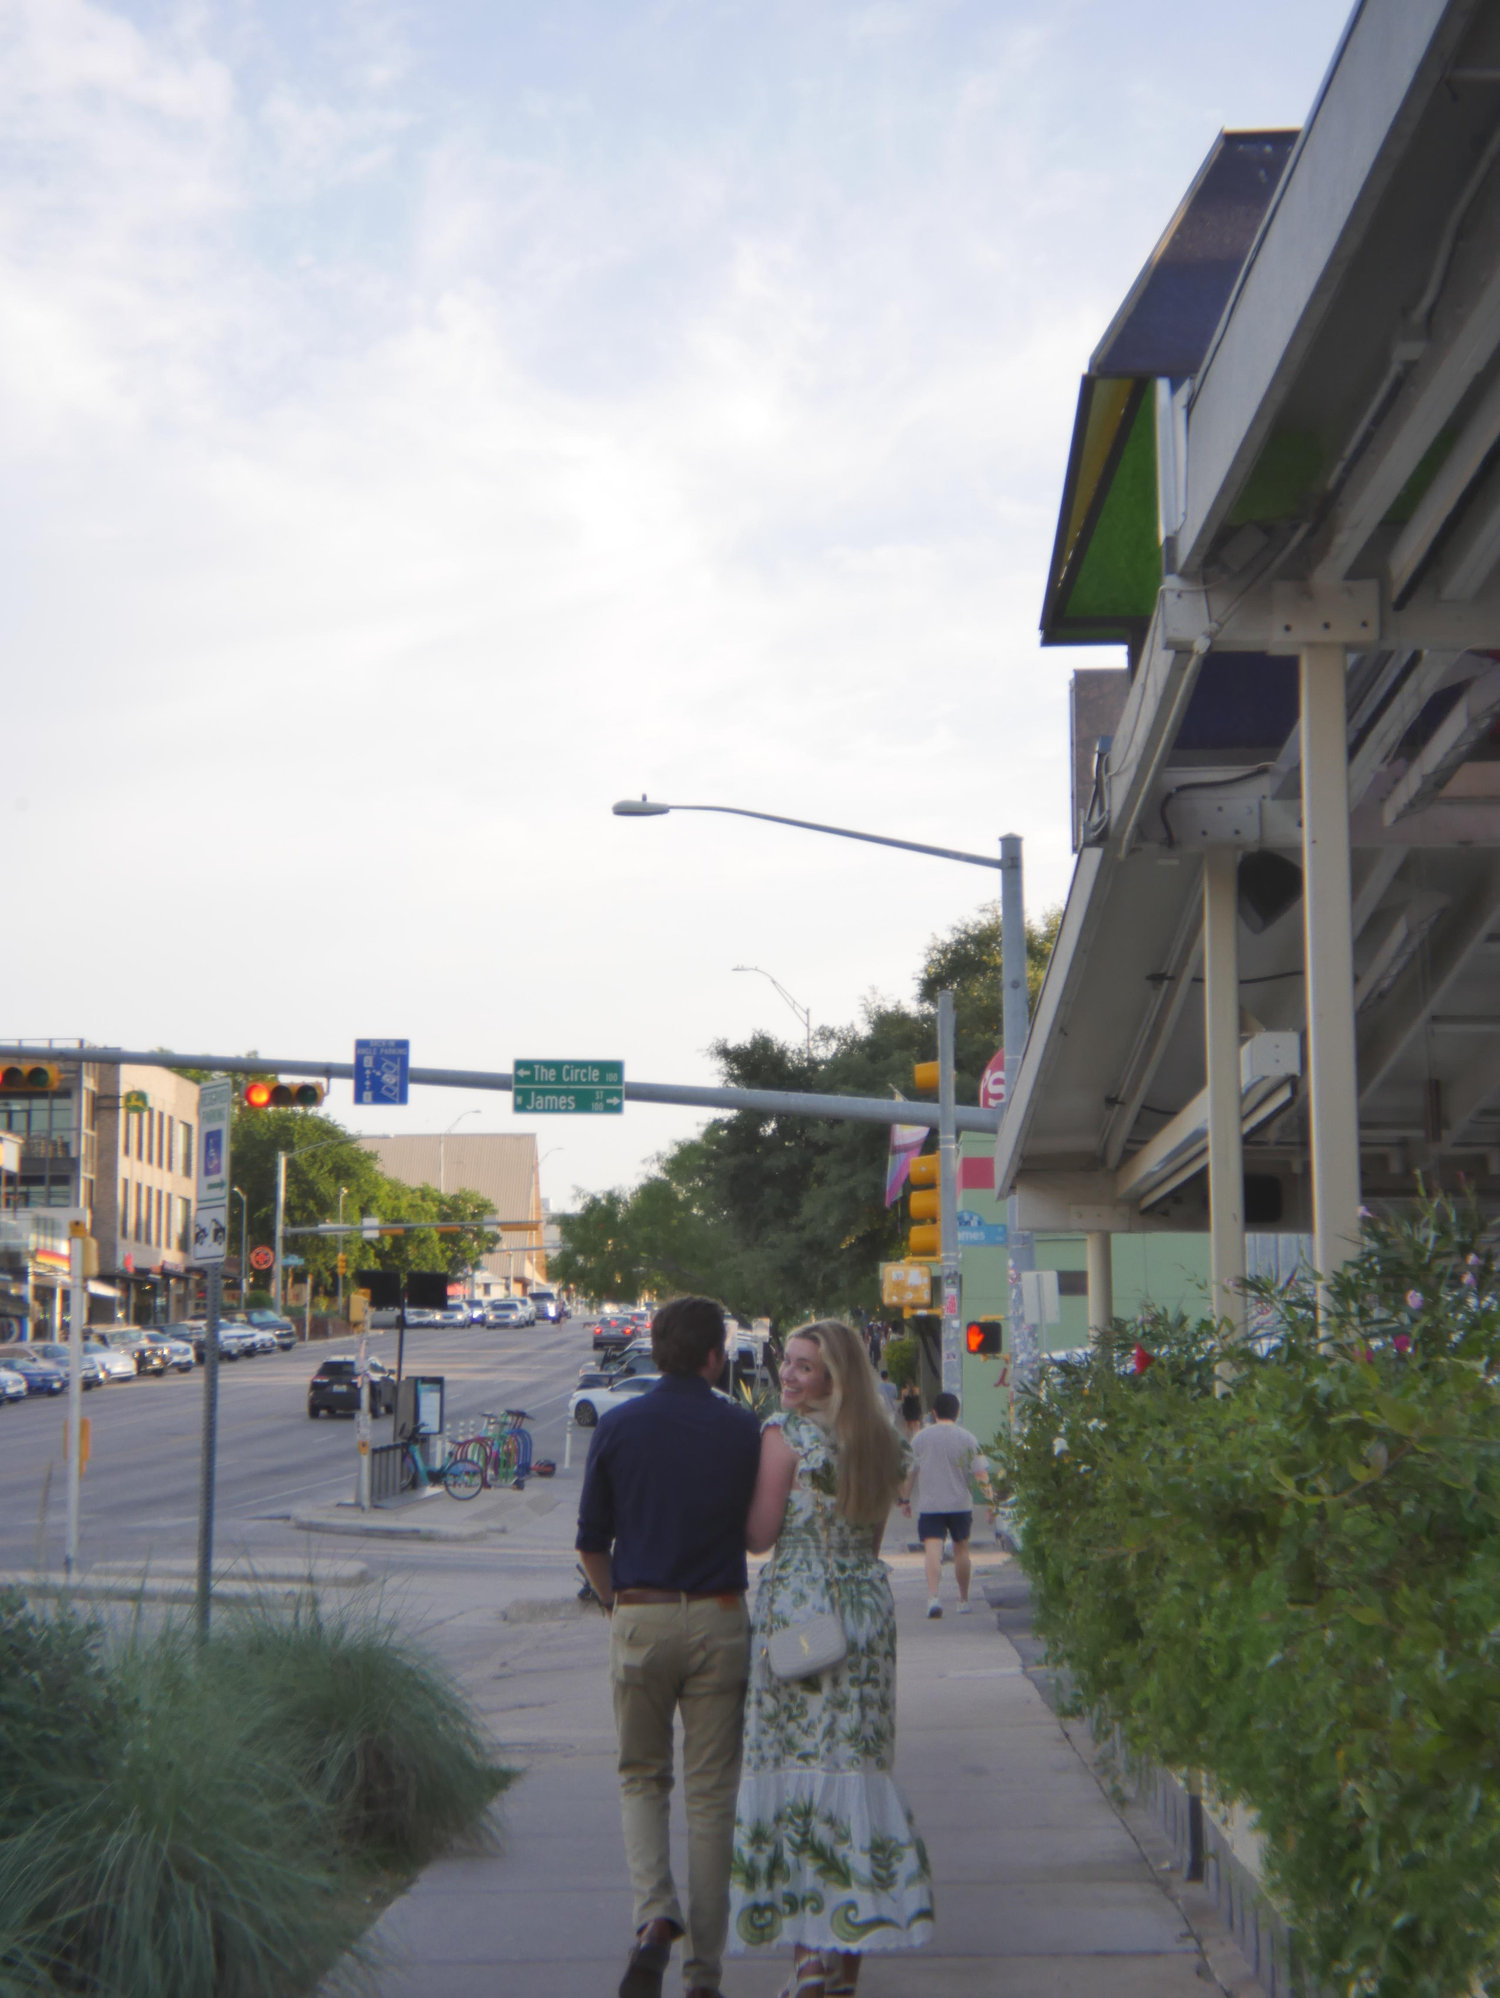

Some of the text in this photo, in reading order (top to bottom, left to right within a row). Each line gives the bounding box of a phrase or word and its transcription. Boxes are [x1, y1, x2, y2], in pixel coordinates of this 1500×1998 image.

[533, 1064, 618, 1083] The Circle 100
[525, 1091, 576, 1110] James
[594, 1090, 604, 1100] ST
[591, 1102, 604, 1111] 100
